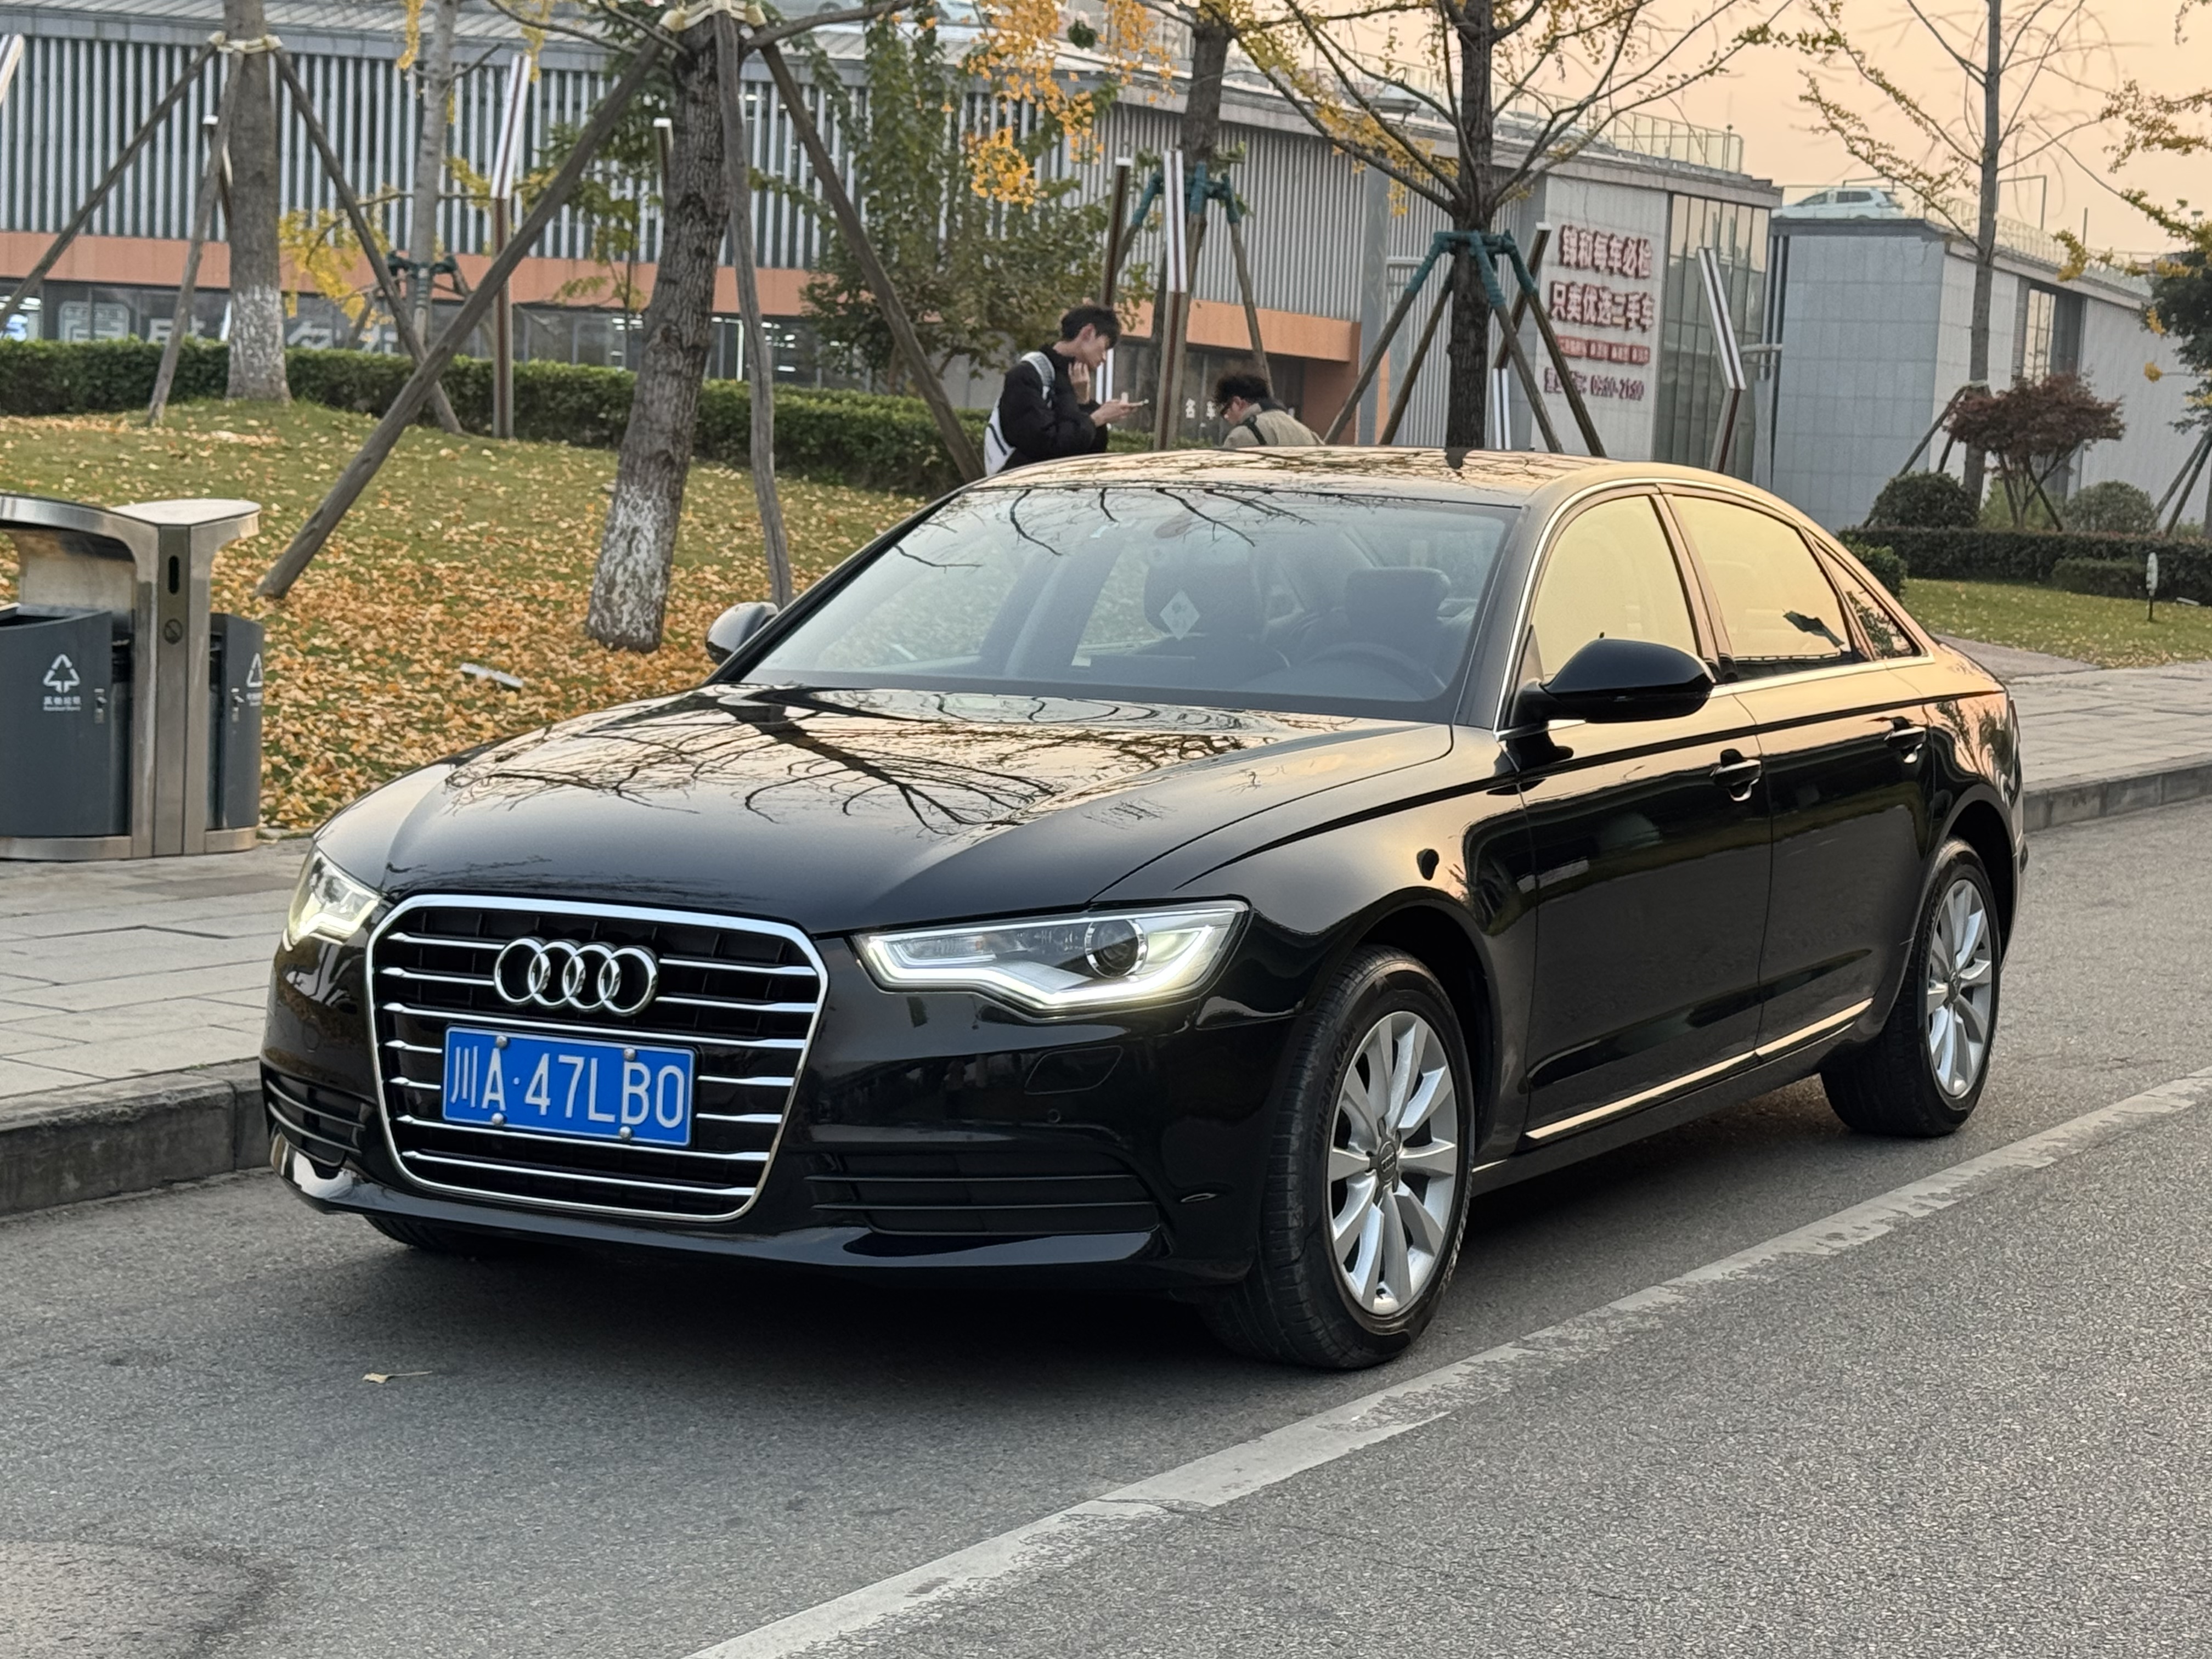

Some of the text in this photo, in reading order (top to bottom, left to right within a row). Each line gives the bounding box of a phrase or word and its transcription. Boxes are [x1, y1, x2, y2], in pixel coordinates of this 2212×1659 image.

[1550, 280, 1655, 332] 只卖优选二手车
[450, 1046, 685, 1128] 川A·47LB0
